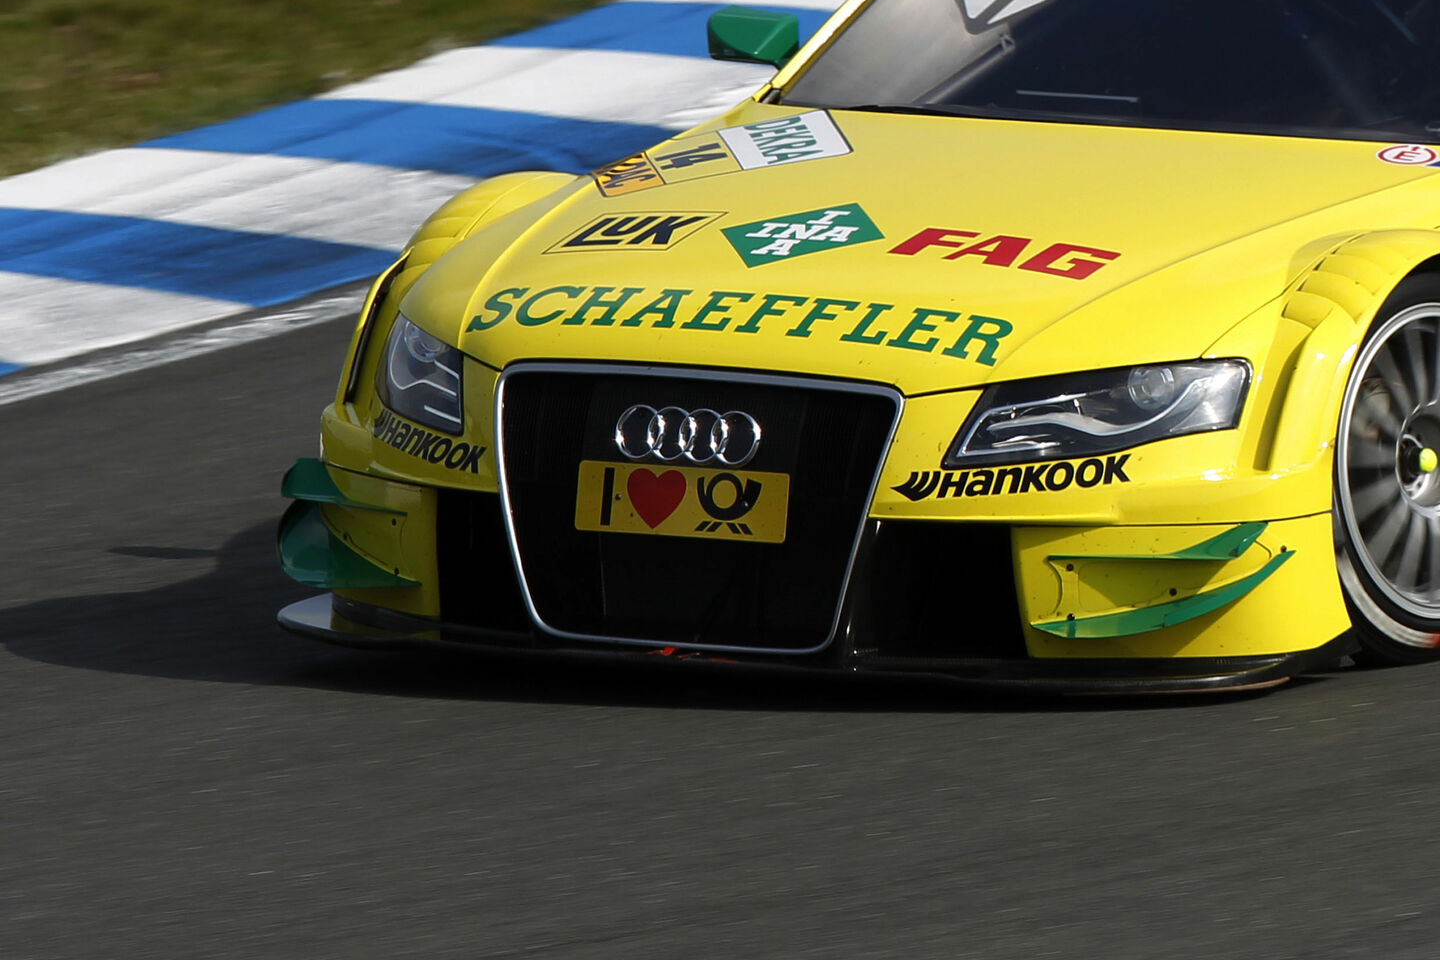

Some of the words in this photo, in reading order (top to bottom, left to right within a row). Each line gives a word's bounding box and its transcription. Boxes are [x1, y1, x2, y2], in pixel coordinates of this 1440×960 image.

[654, 142, 729, 171] 14
[743, 115, 825, 165] DEKRA
[887, 227, 1122, 281] FAG
[465, 285, 1014, 367] SCHAEFFLER
